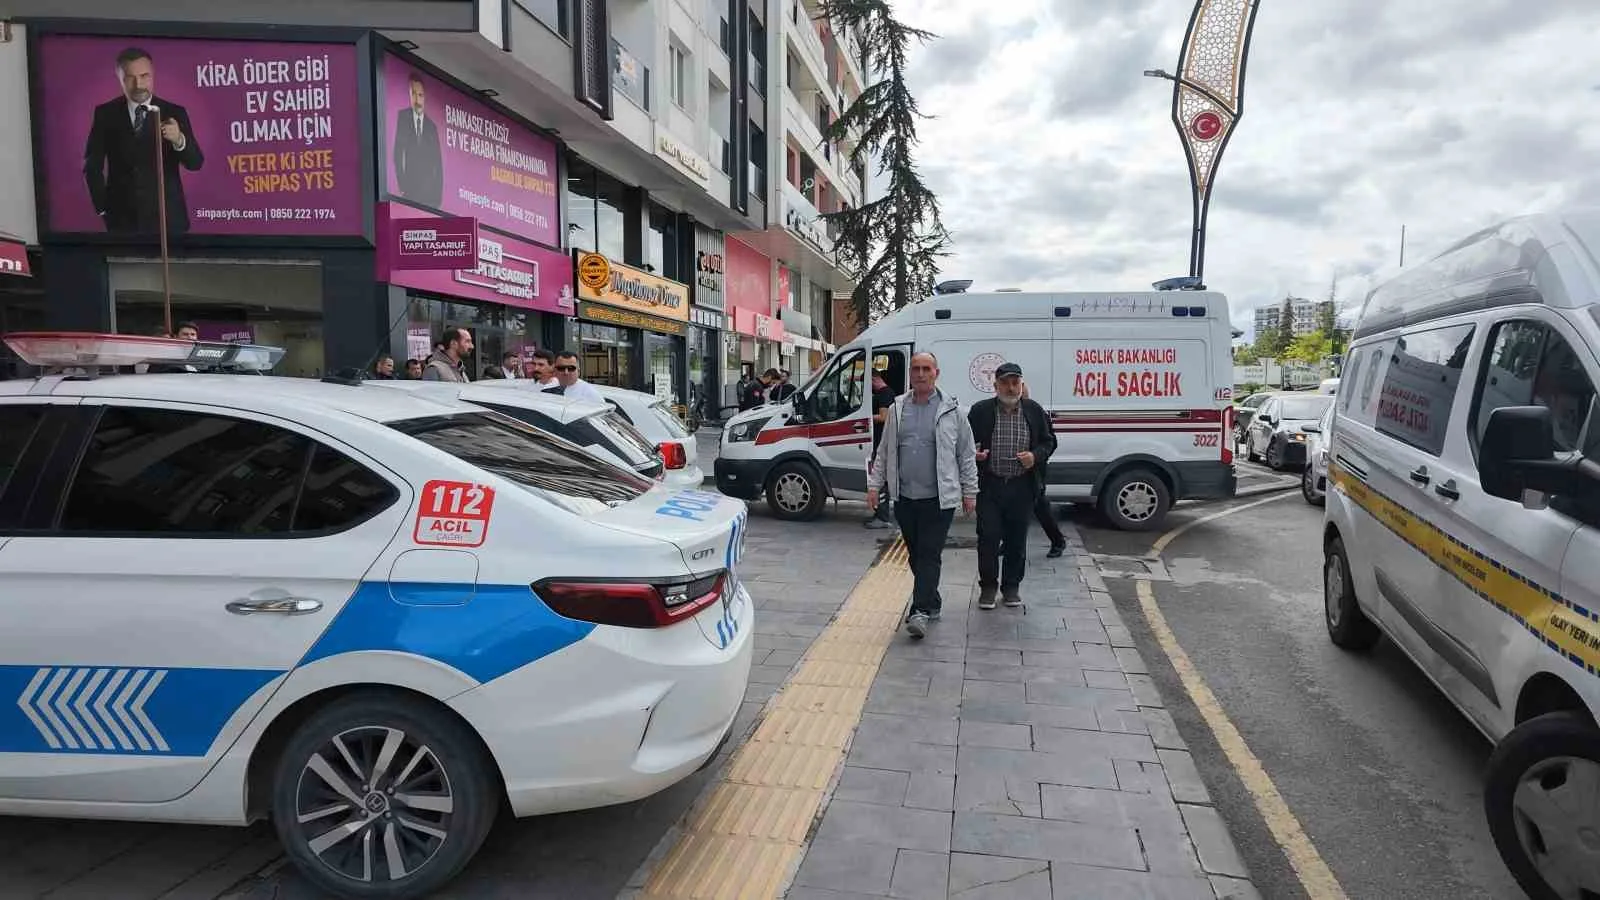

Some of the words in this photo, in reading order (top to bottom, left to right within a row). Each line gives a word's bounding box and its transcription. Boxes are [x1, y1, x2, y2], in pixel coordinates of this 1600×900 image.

[197, 60, 239, 87] KİRA
[243, 58, 290, 84] ÖDER
[295, 54, 329, 82] GİBİ
[246, 91, 268, 113] EV
[273, 83, 330, 112] SAHİBİ
[231, 118, 293, 143] OLMAK
[297, 113, 332, 144] İÇİN
[446, 127, 457, 148] EV
[458, 132, 469, 152] VE
[470, 136, 495, 160] ARABA
[227, 153, 276, 173] YETER
[304, 171, 335, 190] YTS
[197, 208, 262, 220] sinpasyts.com
[271, 208, 293, 219] 0850
[295, 208, 312, 219] 222
[314, 208, 335, 219] 1974
[403, 241, 423, 250] YAPI
[1117, 368, 1182, 397] SAĞLIK
[1193, 434, 1218, 447] 3022
[432, 485, 485, 515] 112
[691, 547, 715, 561] CITY
[1550, 614, 1568, 632] OLAY
